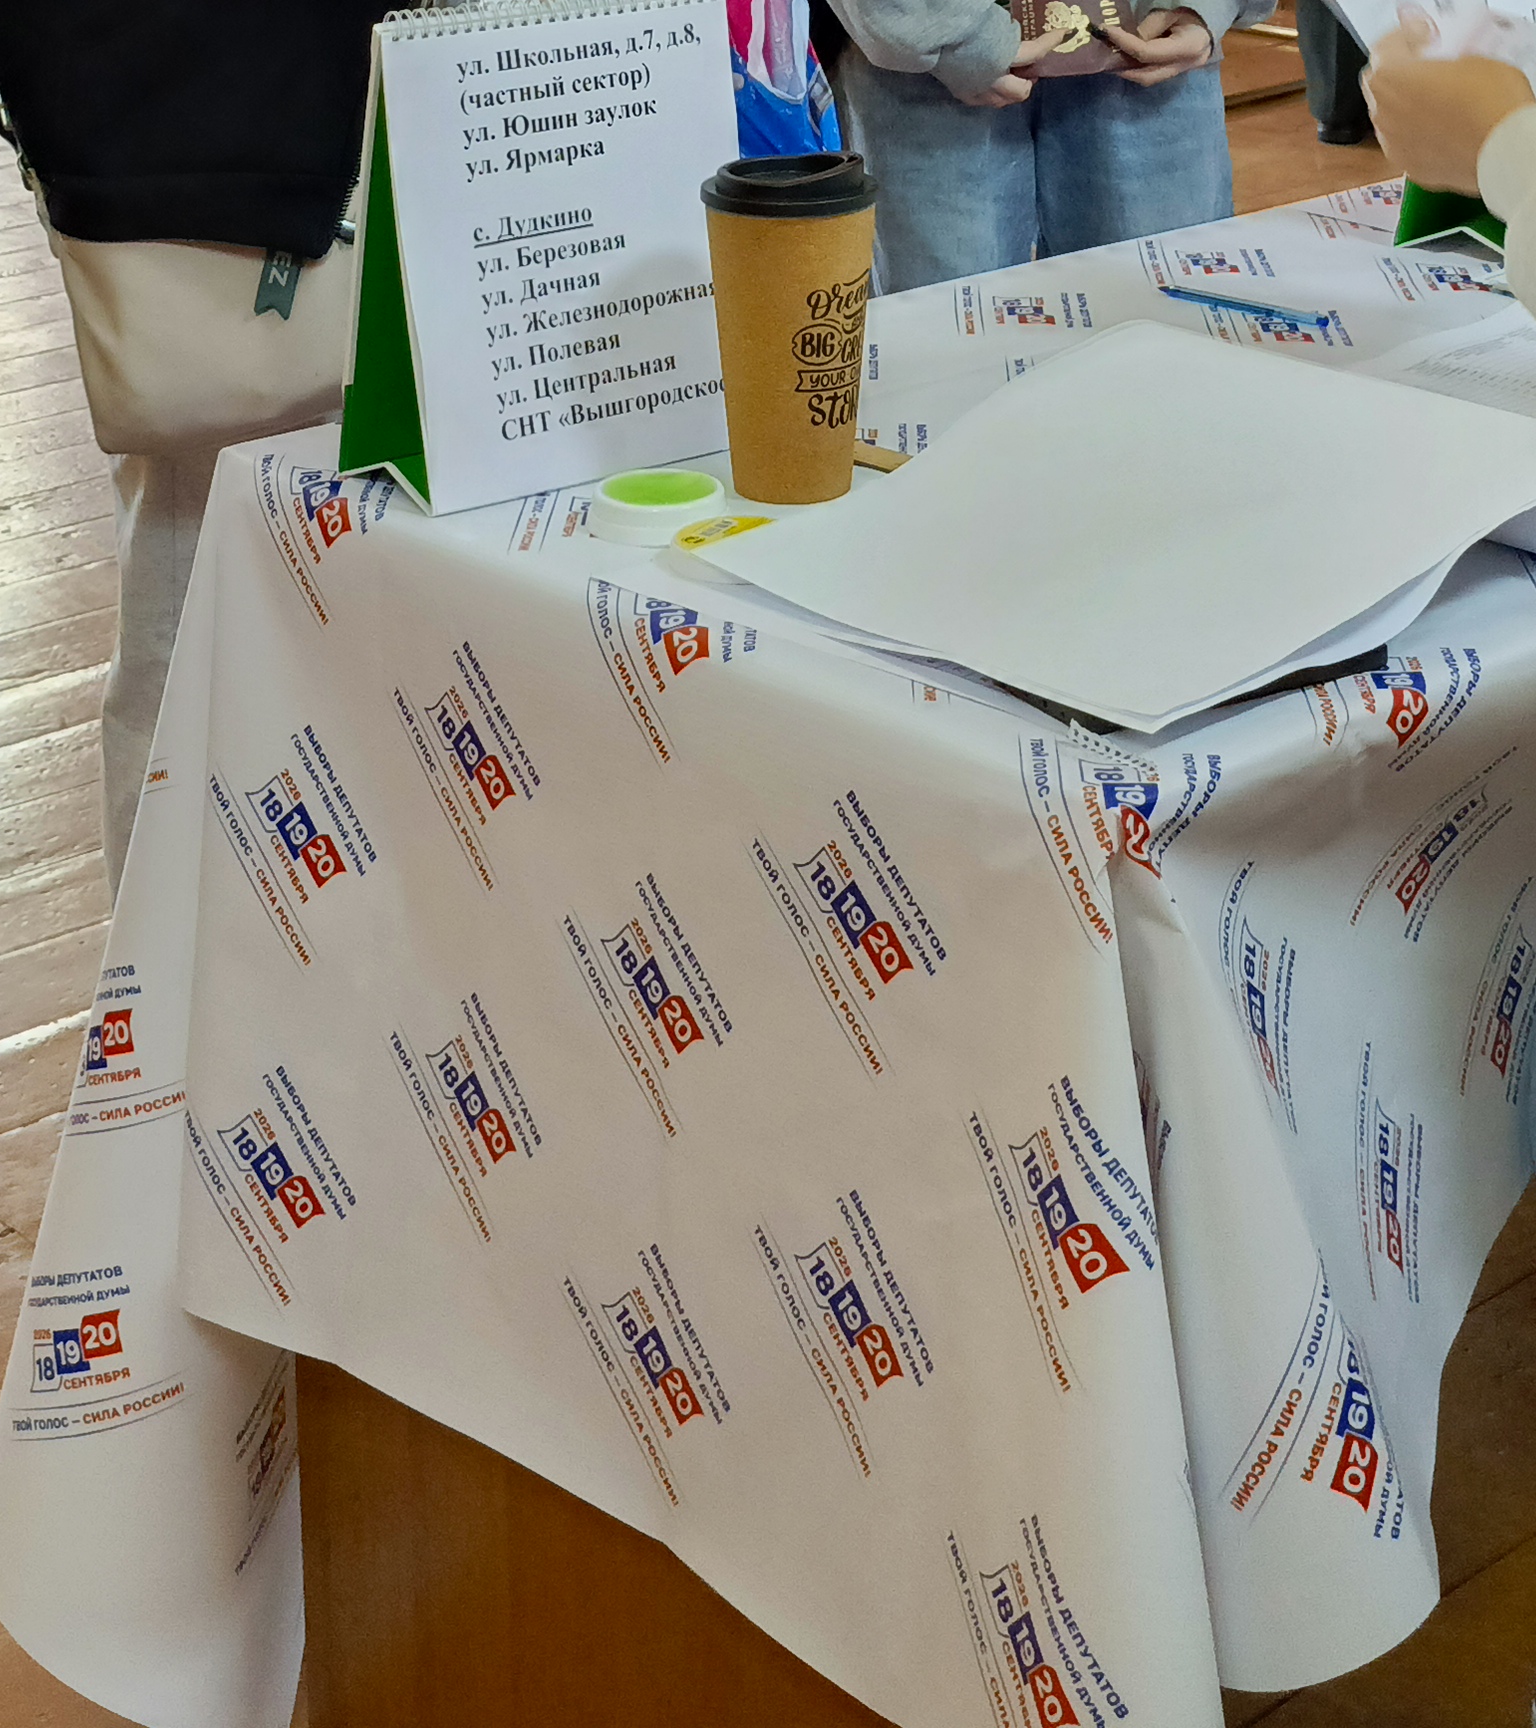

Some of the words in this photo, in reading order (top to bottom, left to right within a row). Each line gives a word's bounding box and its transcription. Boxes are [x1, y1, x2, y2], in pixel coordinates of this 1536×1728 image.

[457, 60, 490, 83] ул.
[496, 39, 620, 72] Школьная,
[625, 29, 661, 55] д.7,
[666, 23, 701, 49] д.8,
[460, 76, 565, 115] (частный
[572, 63, 651, 94] сектор)
[463, 127, 496, 149] ул.
[503, 112, 578, 139] Юшин
[584, 98, 657, 127] заулок
[466, 159, 499, 183] ул.
[505, 140, 605, 173] Ярмарка
[473, 226, 490, 242] с.
[497, 207, 593, 241] Дудкино
[478, 255, 510, 281] ул.
[516, 233, 626, 268] Березовая
[481, 290, 514, 314] ул.
[520, 271, 601, 305] Дачная
[807, 283, 869, 320] Drea
[486, 323, 518, 347] ул.
[491, 356, 522, 380] ул.
[528, 332, 621, 367] Полевая
[801, 332, 835, 358] BIG
[496, 389, 527, 414] ул.
[533, 355, 677, 401] Центральная
[810, 372, 845, 388] YOUR
[501, 410, 551, 441] СНТ
[293, 497, 321, 564] СЕНТЯБРЯ
[310, 483, 331, 506] 19
[323, 501, 342, 537] 20
[280, 531, 298, 567] СИЛА
[297, 567, 329, 625] РОССИИ!
[634, 617, 666, 693] СЕНТЯБРЯ
[659, 611, 686, 629] 19
[673, 628, 698, 663] 20
[597, 593, 613, 639] ГОЛОС
[614, 653, 635, 696] СИЛА
[633, 696, 671, 763] РОССИИ!
[1396, 690, 1423, 734] 20
[437, 706, 455, 739] 18
[458, 729, 478, 766] 19
[480, 759, 505, 801] 20
[494, 703, 540, 788] ДЕПУТАТОВ
[281, 769, 301, 801] 2026
[291, 734, 350, 841] ГОСУДАРСТВЕННОЙ
[344, 839, 366, 877] ДУМЫ
[304, 725, 337, 784] ВЫБОРЫ
[333, 784, 377, 862] ДЕПУТАТОВ
[449, 753, 486, 827] СЕНТЯБРЯ
[1094, 767, 1124, 781] 18
[1115, 785, 1146, 806] 19
[1192, 754, 1221, 818] ВЫБОРЫ
[260, 789, 283, 822] 18
[285, 811, 308, 846] 19
[307, 839, 335, 878] 20
[829, 840, 853, 878] 2026
[1033, 758, 1050, 798] ГОЛОС
[1047, 814, 1073, 866] СИЛА
[1068, 865, 1114, 944] РОССИИ!
[209, 774, 229, 811] ТВОЙ
[226, 812, 252, 856] ГОЛОС
[256, 869, 277, 906] СИЛА
[276, 906, 311, 966] РОССИИ!
[270, 835, 309, 904] СЕНТЯБРЯ
[835, 801, 912, 932] ГОСУДАРСТВЕННОЙ
[908, 931, 936, 978] ДУМЫ
[848, 793, 890, 862] ВЫБОРЫ
[888, 864, 946, 962] ДЕПУТАТОВ
[810, 862, 835, 900] 18
[839, 891, 866, 932] 19
[867, 926, 900, 974] 20
[615, 939, 636, 975] 18
[640, 966, 663, 1005] 19
[664, 999, 692, 1044] 20
[681, 942, 731, 1033] ДЕПУТАТОВ
[755, 839, 778, 883] ТВОЙ
[776, 884, 808, 938] ГОЛОС
[815, 954, 840, 1000] СИЛА
[841, 1002, 886, 1078] РОССИИ!
[826, 916, 875, 1002] СЕНТЯБРЯ
[88, 1036, 101, 1061] 19
[104, 1020, 129, 1046] 20
[88, 1067, 141, 1086] СЕНТЯБРЯ
[438, 1054, 458, 1088] 18
[461, 1081, 481, 1118] 19
[482, 1112, 506, 1154] 20
[500, 1060, 541, 1144] ДЕПУТАТОВ
[99, 1107, 131, 1122] СИЛА
[1040, 1126, 1059, 1171] 2026
[1060, 1075, 1109, 1158] ВЫБОРЫ
[233, 1128, 257, 1160] 18
[259, 1151, 284, 1186] 19
[283, 1180, 313, 1219] 20
[308, 1127, 356, 1206] ДЕПУТАТОВ
[1047, 1083, 1132, 1231] ГОСУДАРСТВЕННОЙ
[1125, 1224, 1155, 1271] ДУМЫ
[245, 1174, 287, 1244] СЕНТЯБРЯ
[1022, 1148, 1044, 1192] 18
[1044, 1186, 1067, 1231] 19
[1067, 1228, 1107, 1280] 20
[57, 1265, 123, 1287] ДЕПУТАТОВ
[253, 1246, 291, 1307] РОССИИ!
[969, 1111, 995, 1165] ТВОЙ
[990, 1164, 1017, 1229] ГОЛОС
[1019, 1248, 1038, 1302] СИЛА
[1037, 1305, 1071, 1393] РОССИИ!
[1031, 1209, 1069, 1310] СЕНТЯБРЯ
[36, 1357, 56, 1381] 18
[57, 1340, 80, 1365] 19
[83, 1322, 116, 1349] 20
[810, 1257, 834, 1296] 18
[837, 1290, 862, 1332] 19
[862, 1329, 892, 1377] 20
[64, 1367, 130, 1390] СЕНТЯБРЯ
[616, 1305, 638, 1342] 18
[642, 1336, 664, 1375] 19
[665, 1372, 692, 1416] 20
[683, 1318, 730, 1411] ДЕПУТАТОВ
[83, 1407, 121, 1424] СИЛА
[123, 1382, 184, 1415] РОССИИ!
[1270, 1388, 1302, 1438] СИЛА
[1300, 1382, 1342, 1484] СЕНТЯБРЯ
[1347, 1391, 1370, 1432] 19
[1231, 1439, 1279, 1512] РОССИИ!
[1343, 1440, 1371, 1493] 20
[992, 1577, 1013, 1623] 18
[1016, 1622, 1035, 1668] 19
[1035, 1670, 1063, 1724] 20
